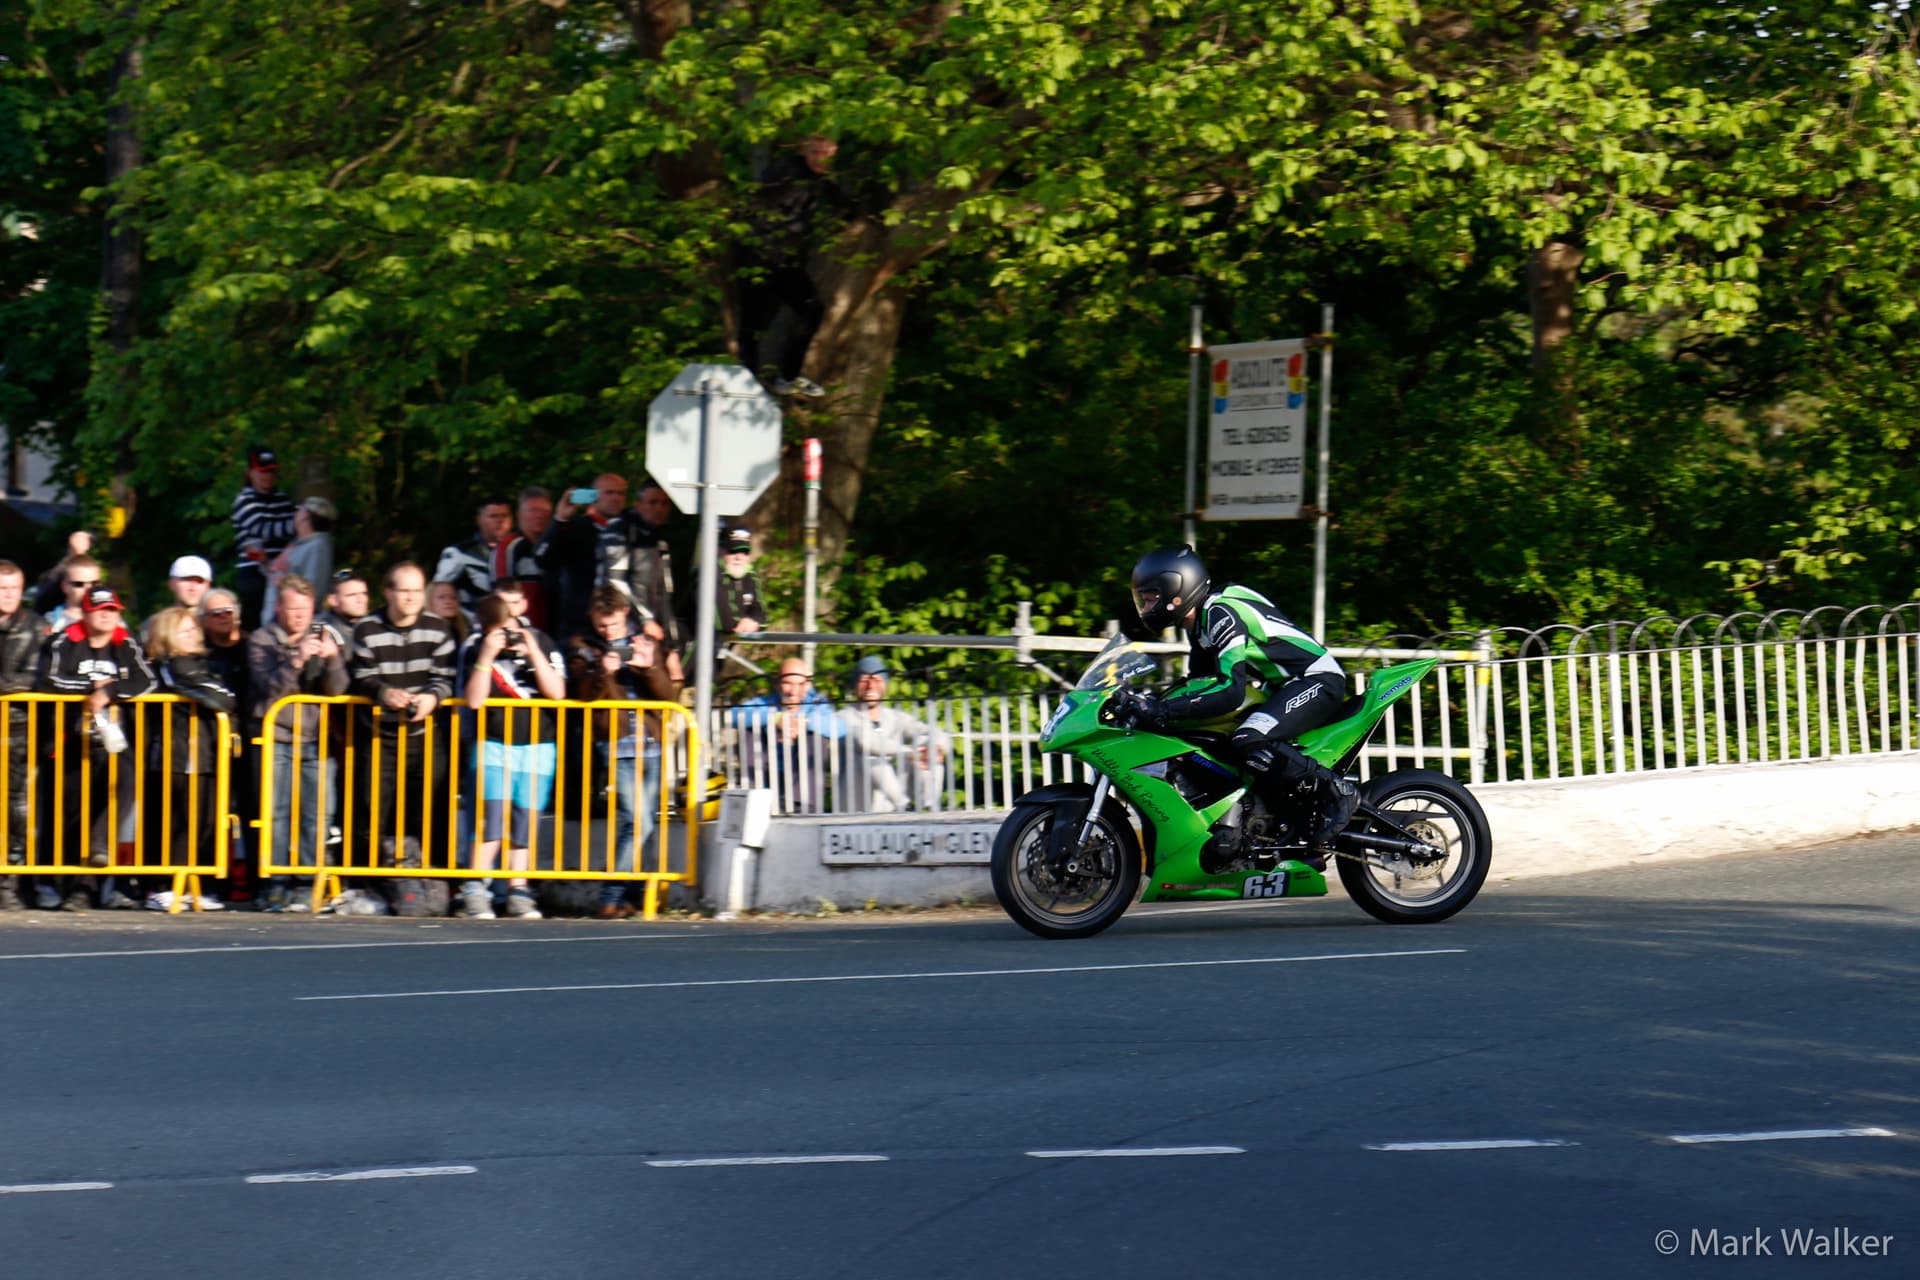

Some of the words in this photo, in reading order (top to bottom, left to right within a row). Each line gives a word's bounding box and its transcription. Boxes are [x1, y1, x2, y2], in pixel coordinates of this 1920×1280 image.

[1285, 682, 1324, 714] RST
[1378, 676, 1413, 701] wemoto
[1139, 790, 1171, 823] Racing
[830, 832, 935, 856] BALLAUGH
[1243, 871, 1287, 899] 63
